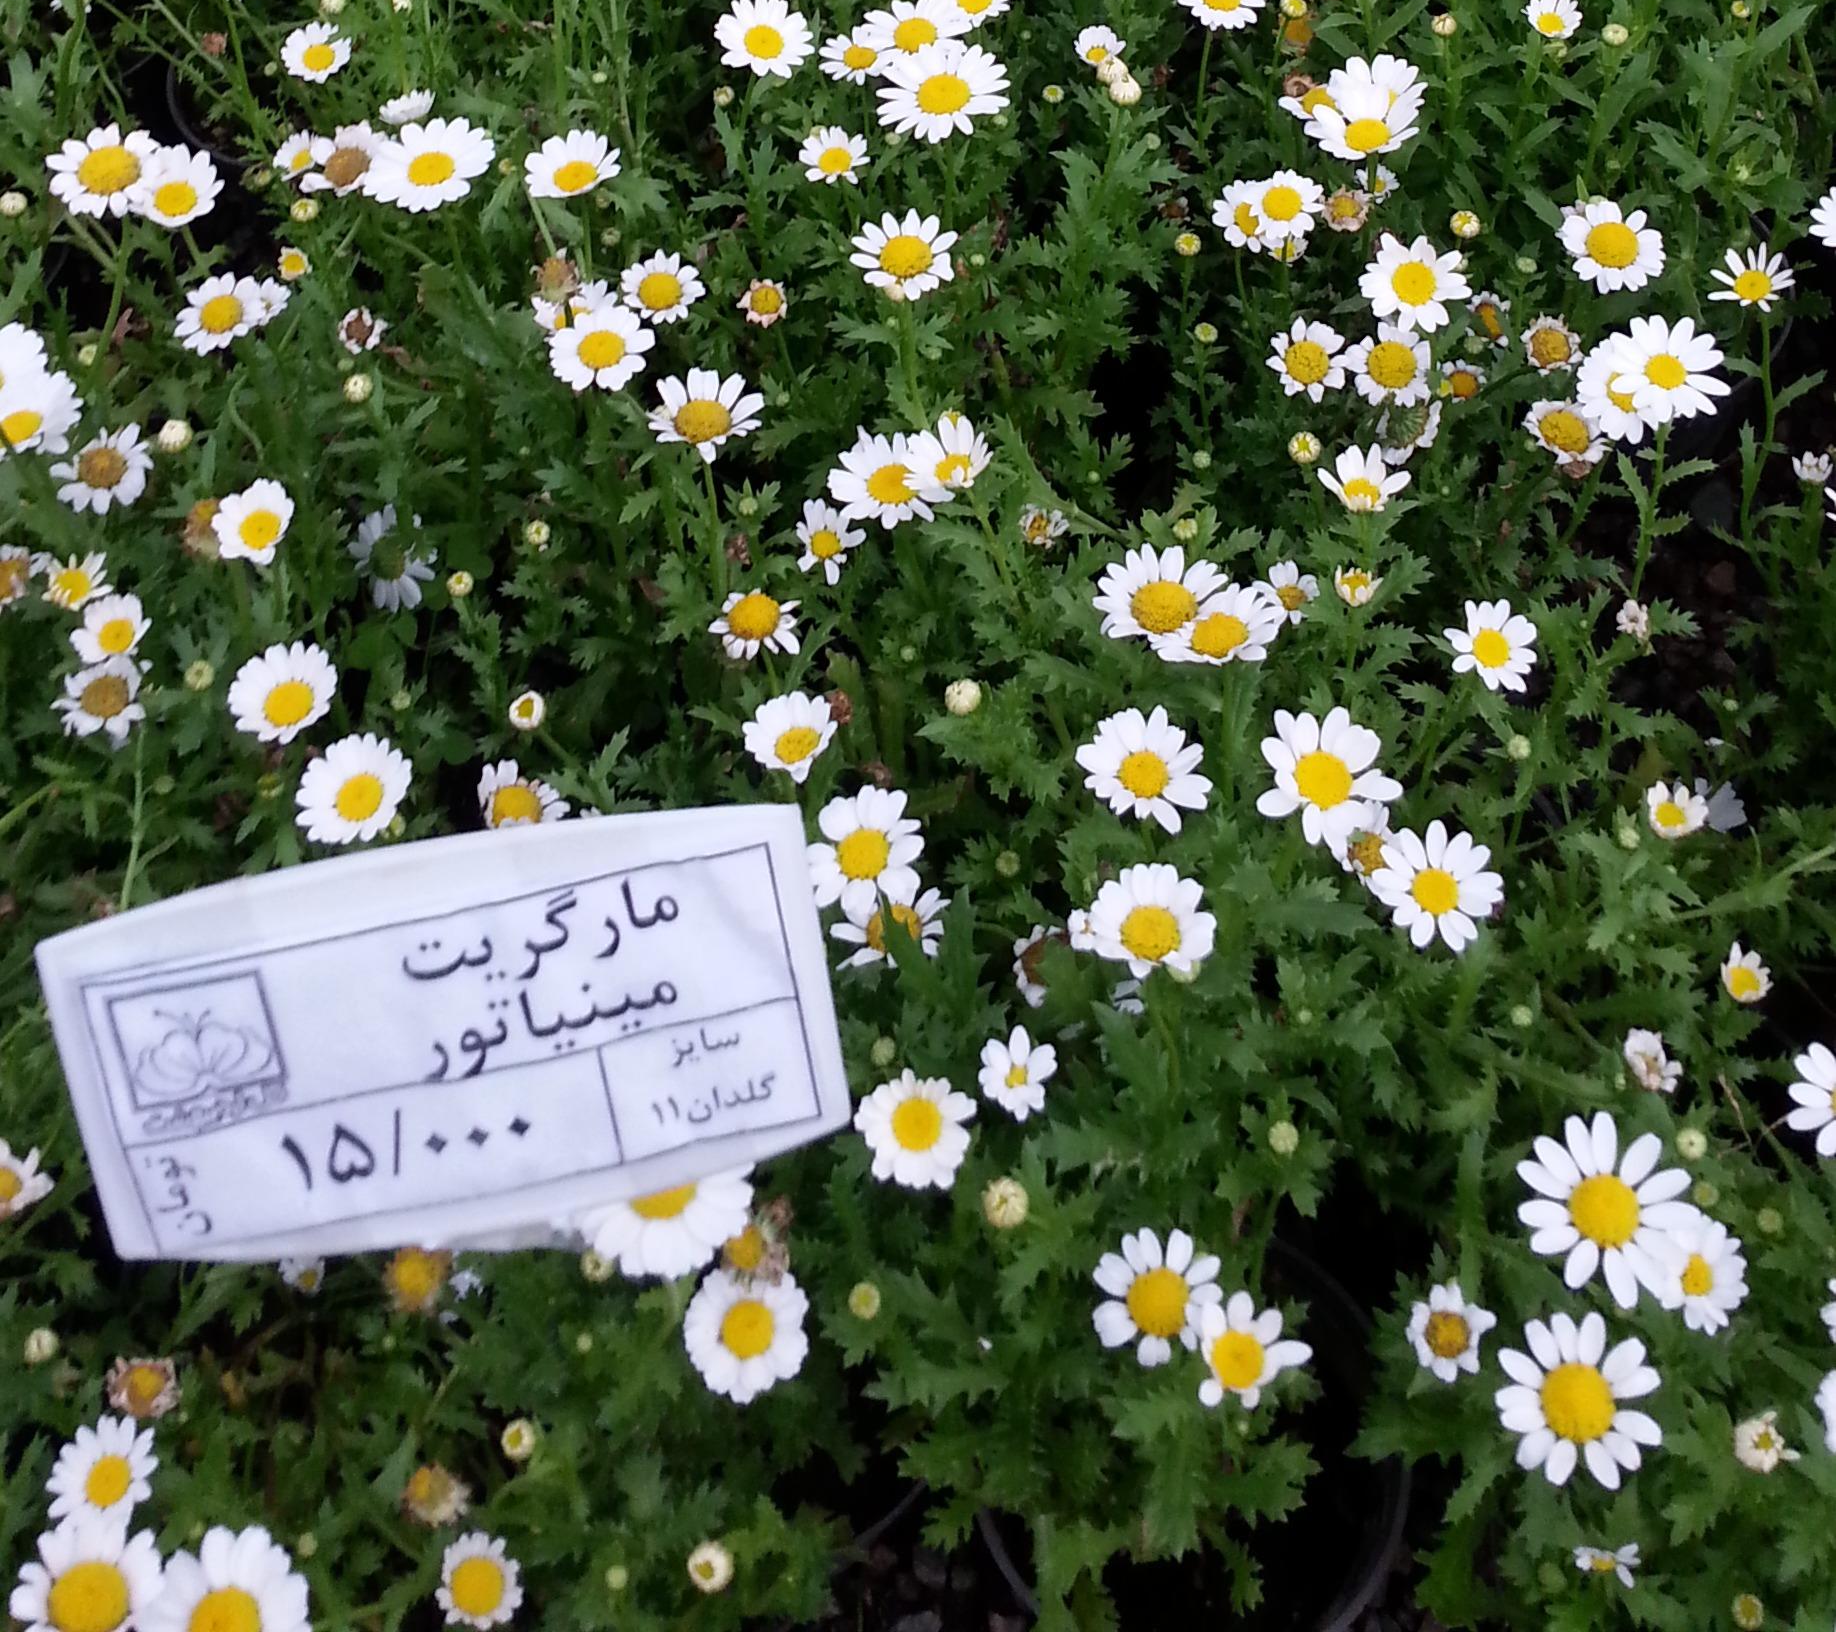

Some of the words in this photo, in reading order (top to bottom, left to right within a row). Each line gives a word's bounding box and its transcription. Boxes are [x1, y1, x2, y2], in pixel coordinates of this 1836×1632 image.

[402, 877, 679, 982] مارگریت
[423, 980, 678, 1082] مینیاتور
[672, 1027, 741, 1069] سایز
